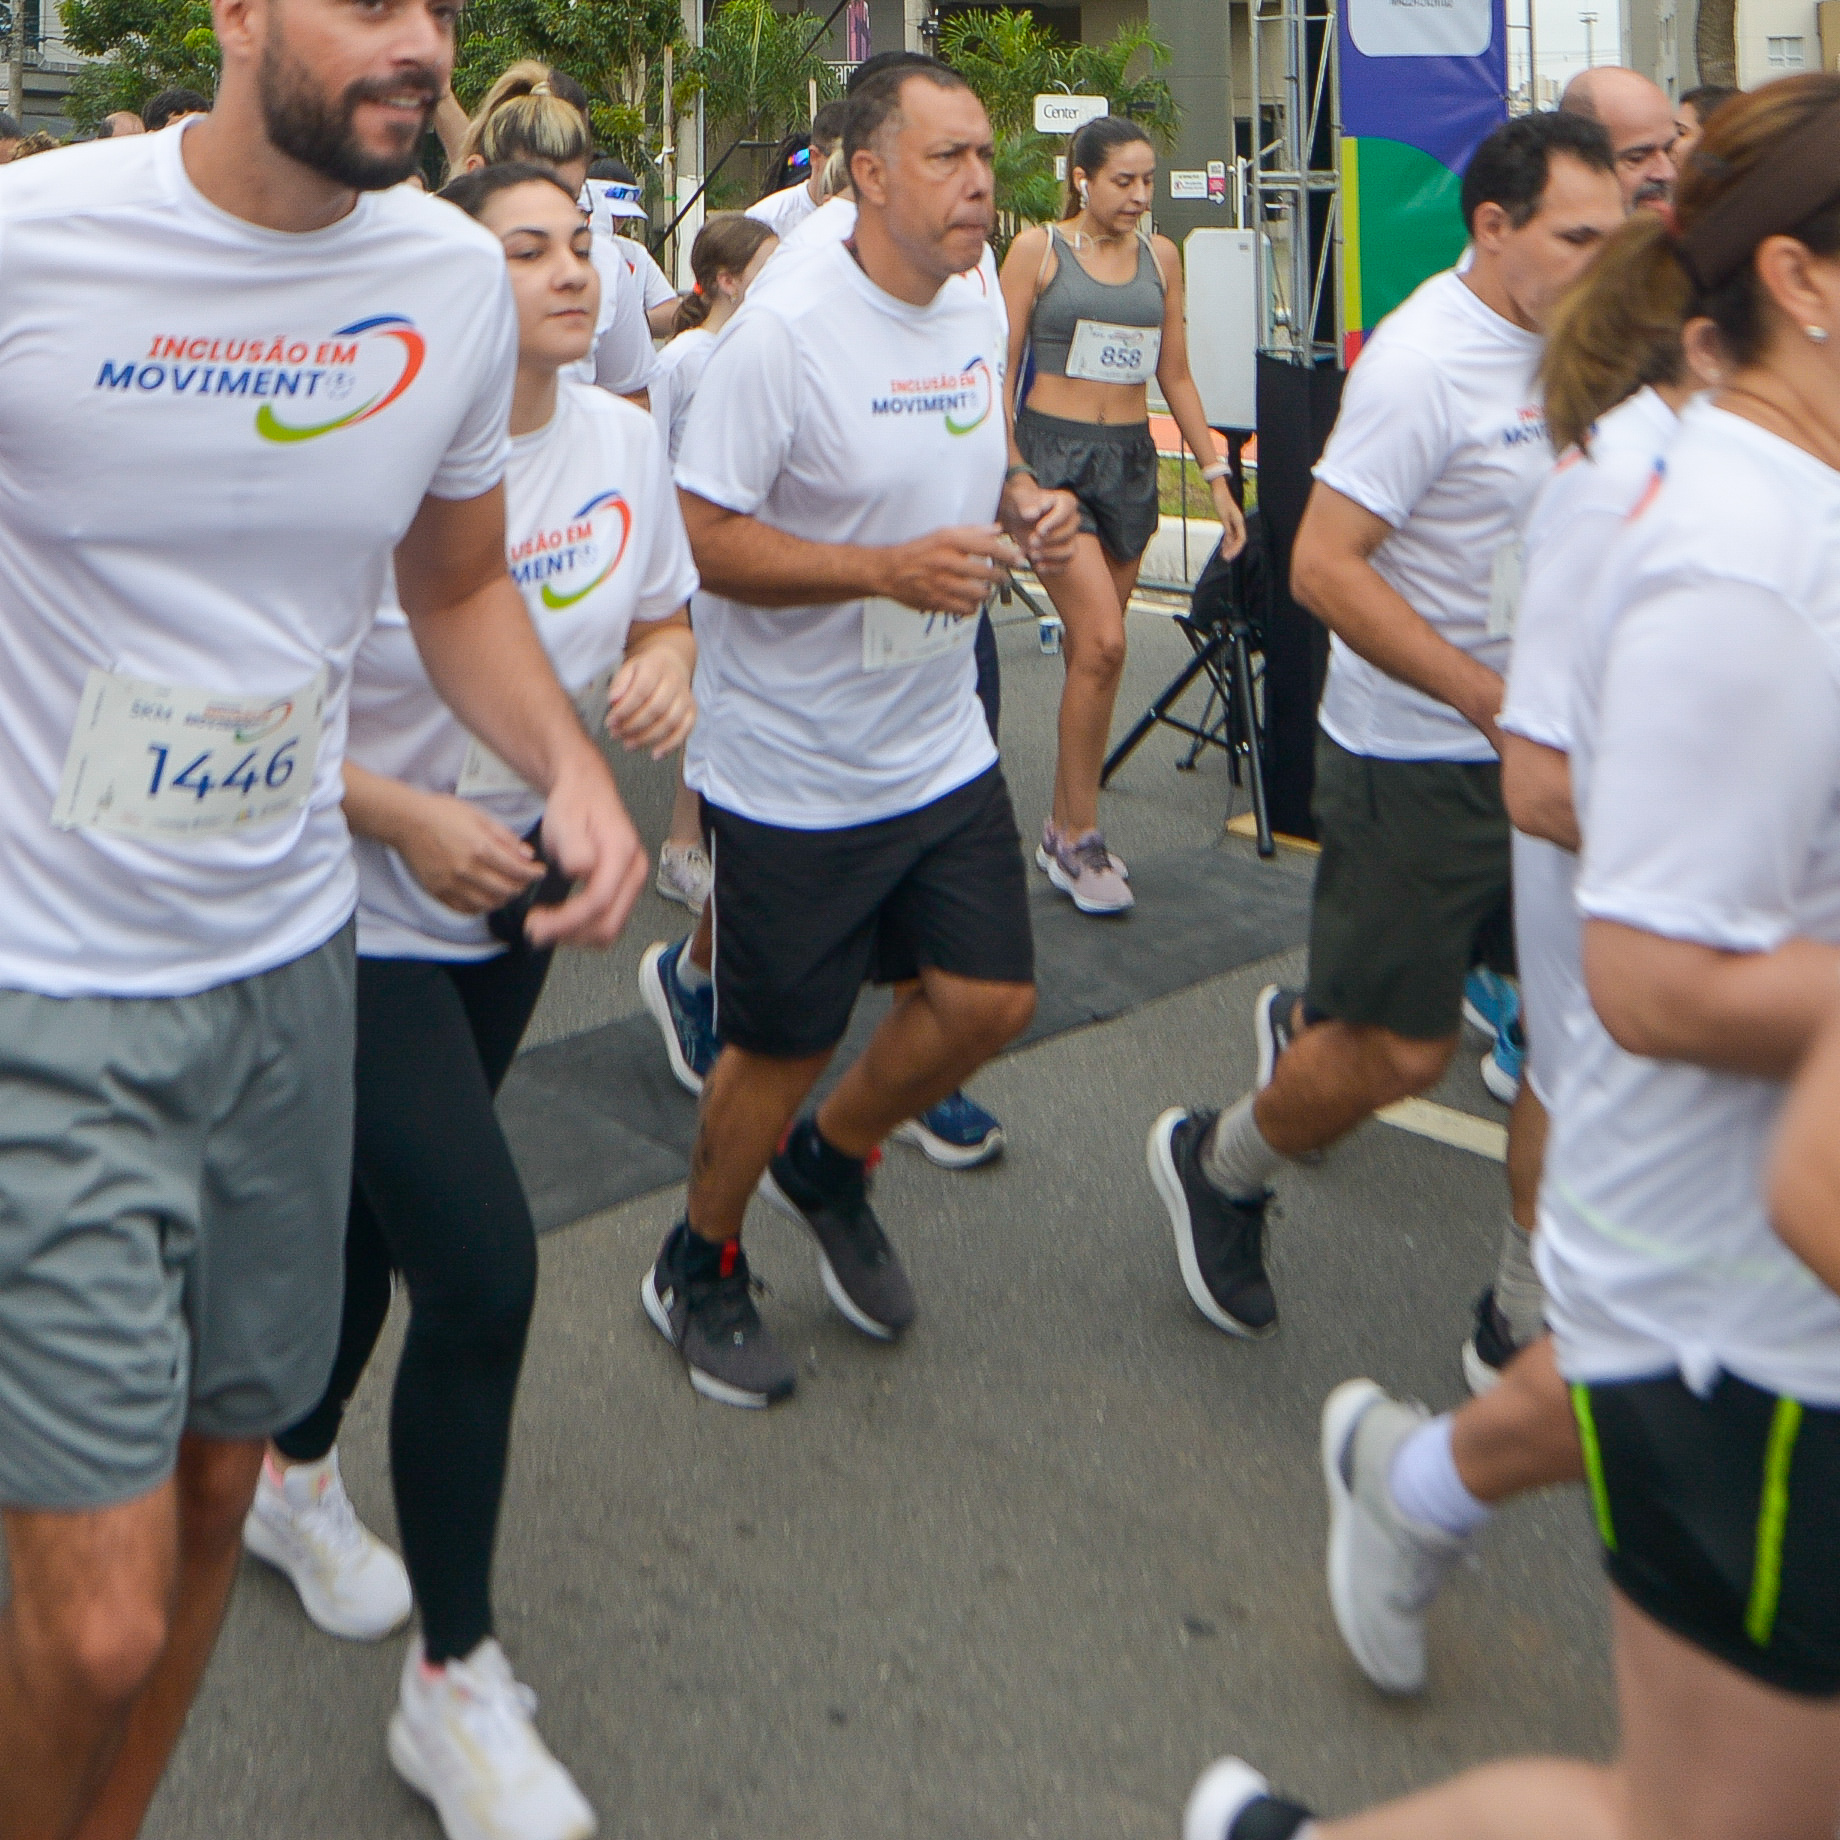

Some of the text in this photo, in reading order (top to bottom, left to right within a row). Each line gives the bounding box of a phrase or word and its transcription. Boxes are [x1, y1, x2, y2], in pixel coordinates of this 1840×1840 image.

[1044, 104, 1079, 119] Center
[147, 333, 359, 365] INCLUSÃO EM
[1101, 345, 1142, 369] 858
[891, 371, 977, 394] INCLUSÃO EM
[566, 521, 593, 545] EM
[147, 736, 300, 801] 1446
